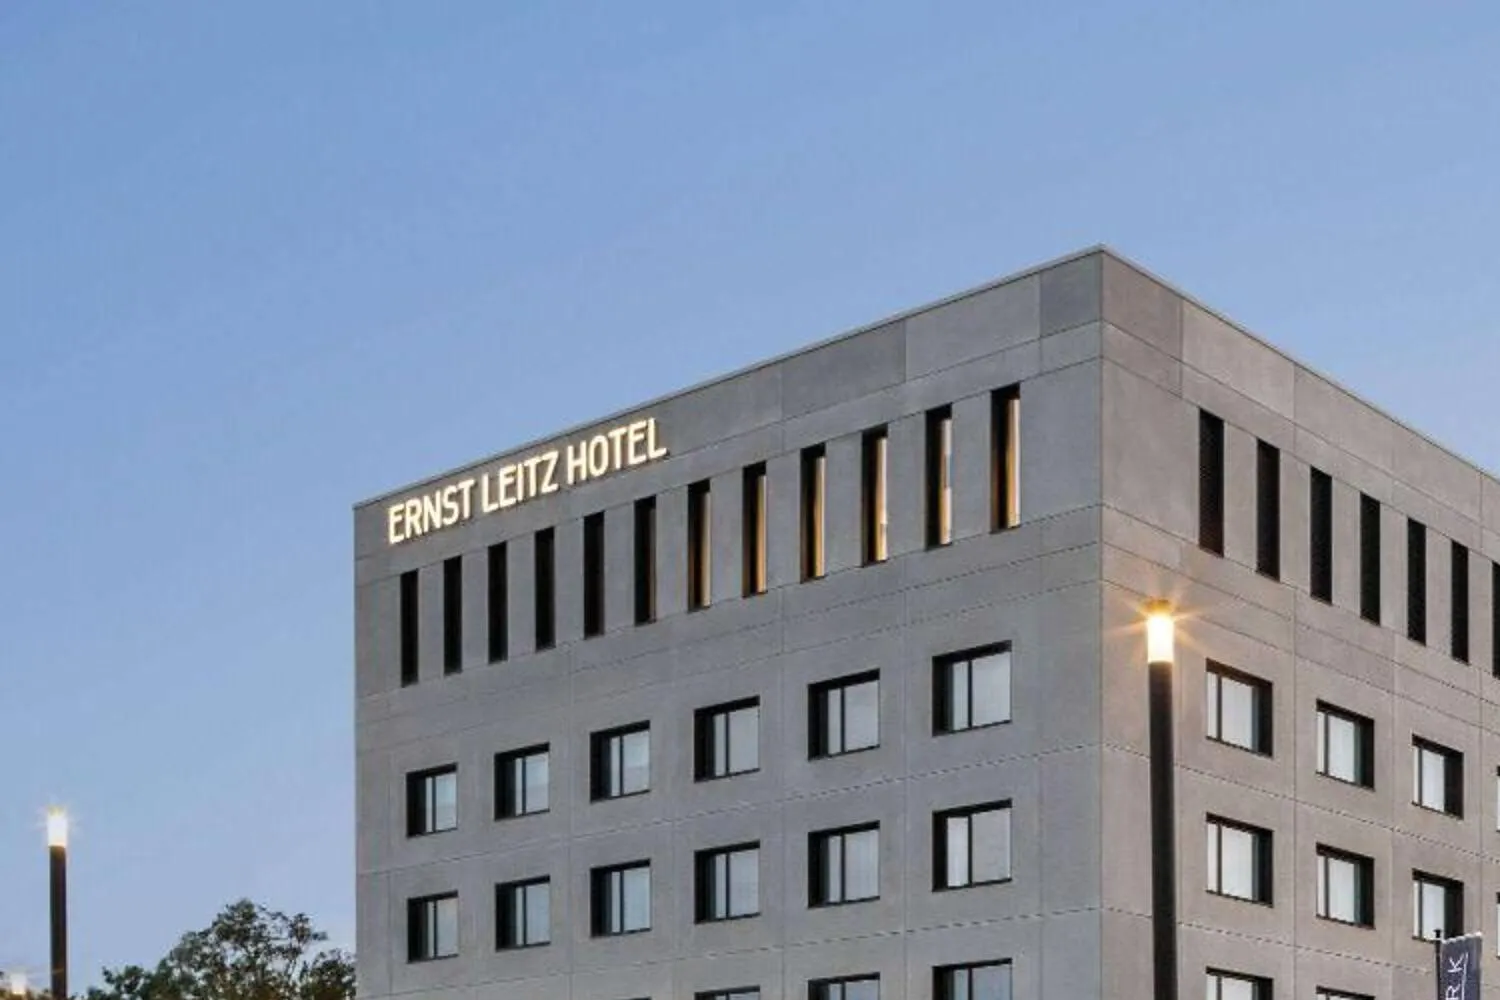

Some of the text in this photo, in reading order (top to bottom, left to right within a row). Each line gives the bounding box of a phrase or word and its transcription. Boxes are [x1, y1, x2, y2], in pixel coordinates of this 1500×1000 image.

[388, 417, 667, 545] ERNST LEITZ HOTEL
